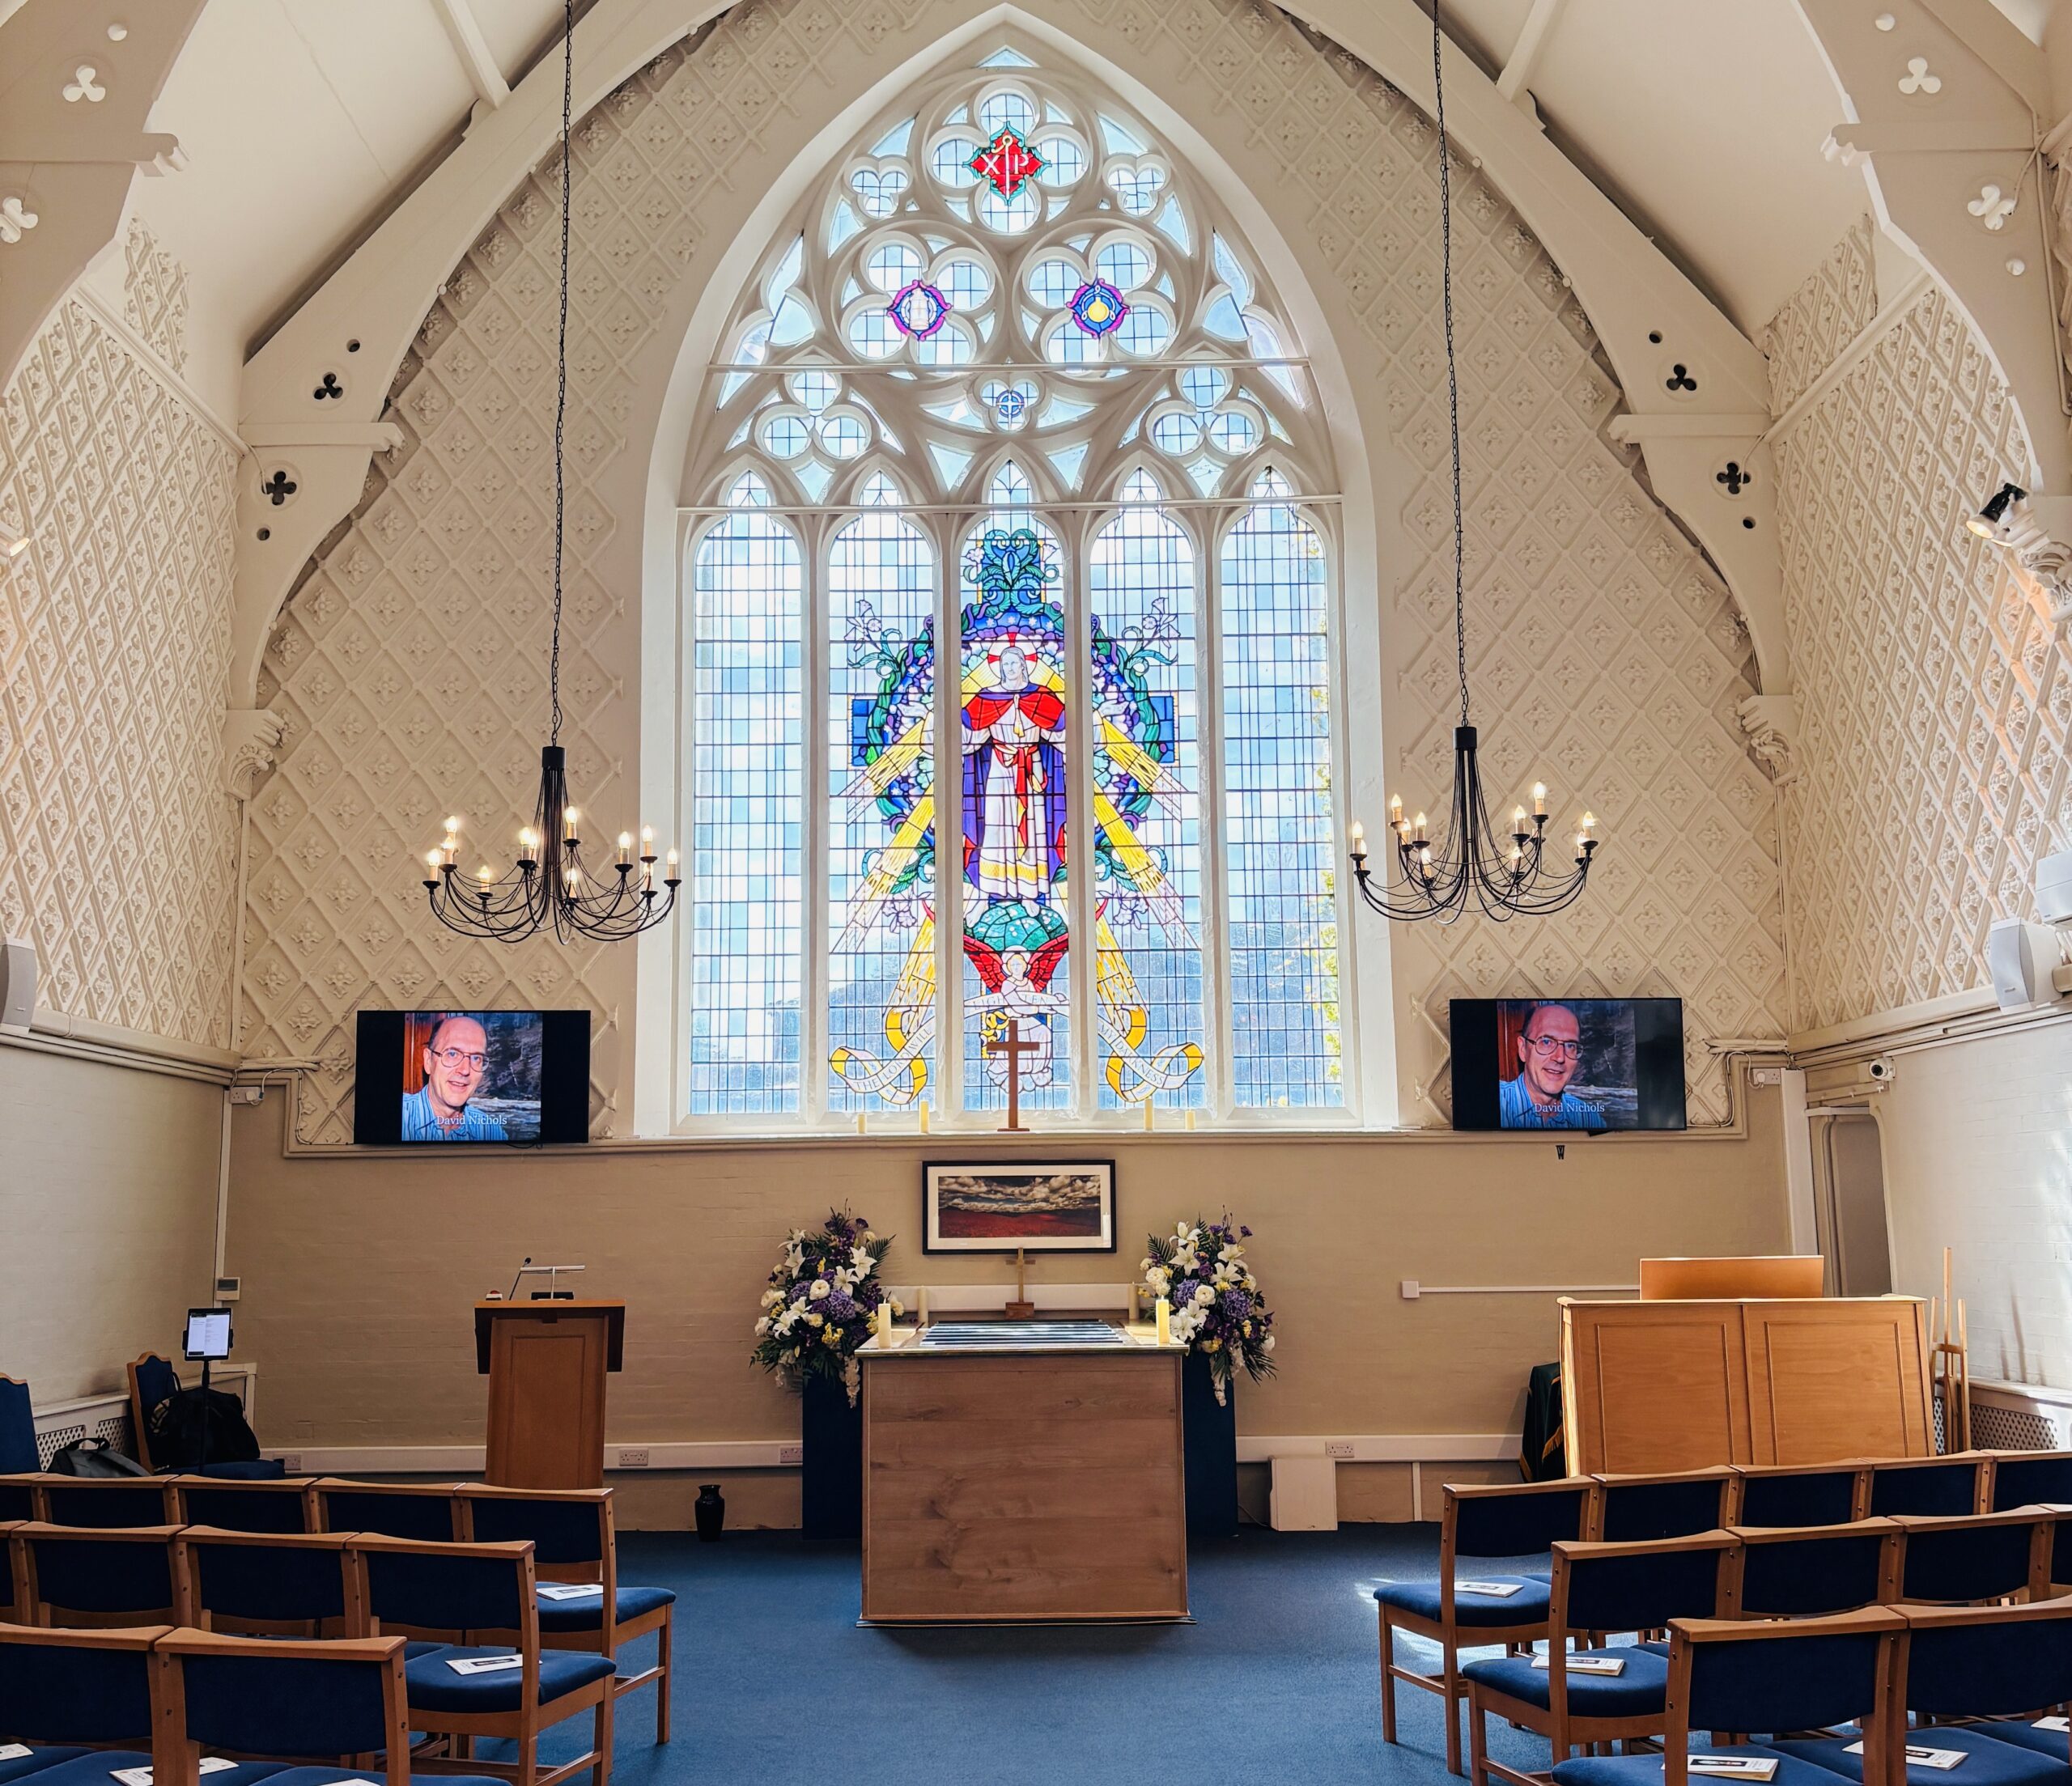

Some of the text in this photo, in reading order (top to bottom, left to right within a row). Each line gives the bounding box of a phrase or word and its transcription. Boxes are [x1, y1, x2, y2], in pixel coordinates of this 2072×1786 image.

[853, 1078, 880, 1091] THE
[908, 1029, 932, 1050] WILL
[1534, 1102, 1605, 1113] David Nichols
[436, 1114, 507, 1125] David Nichols
